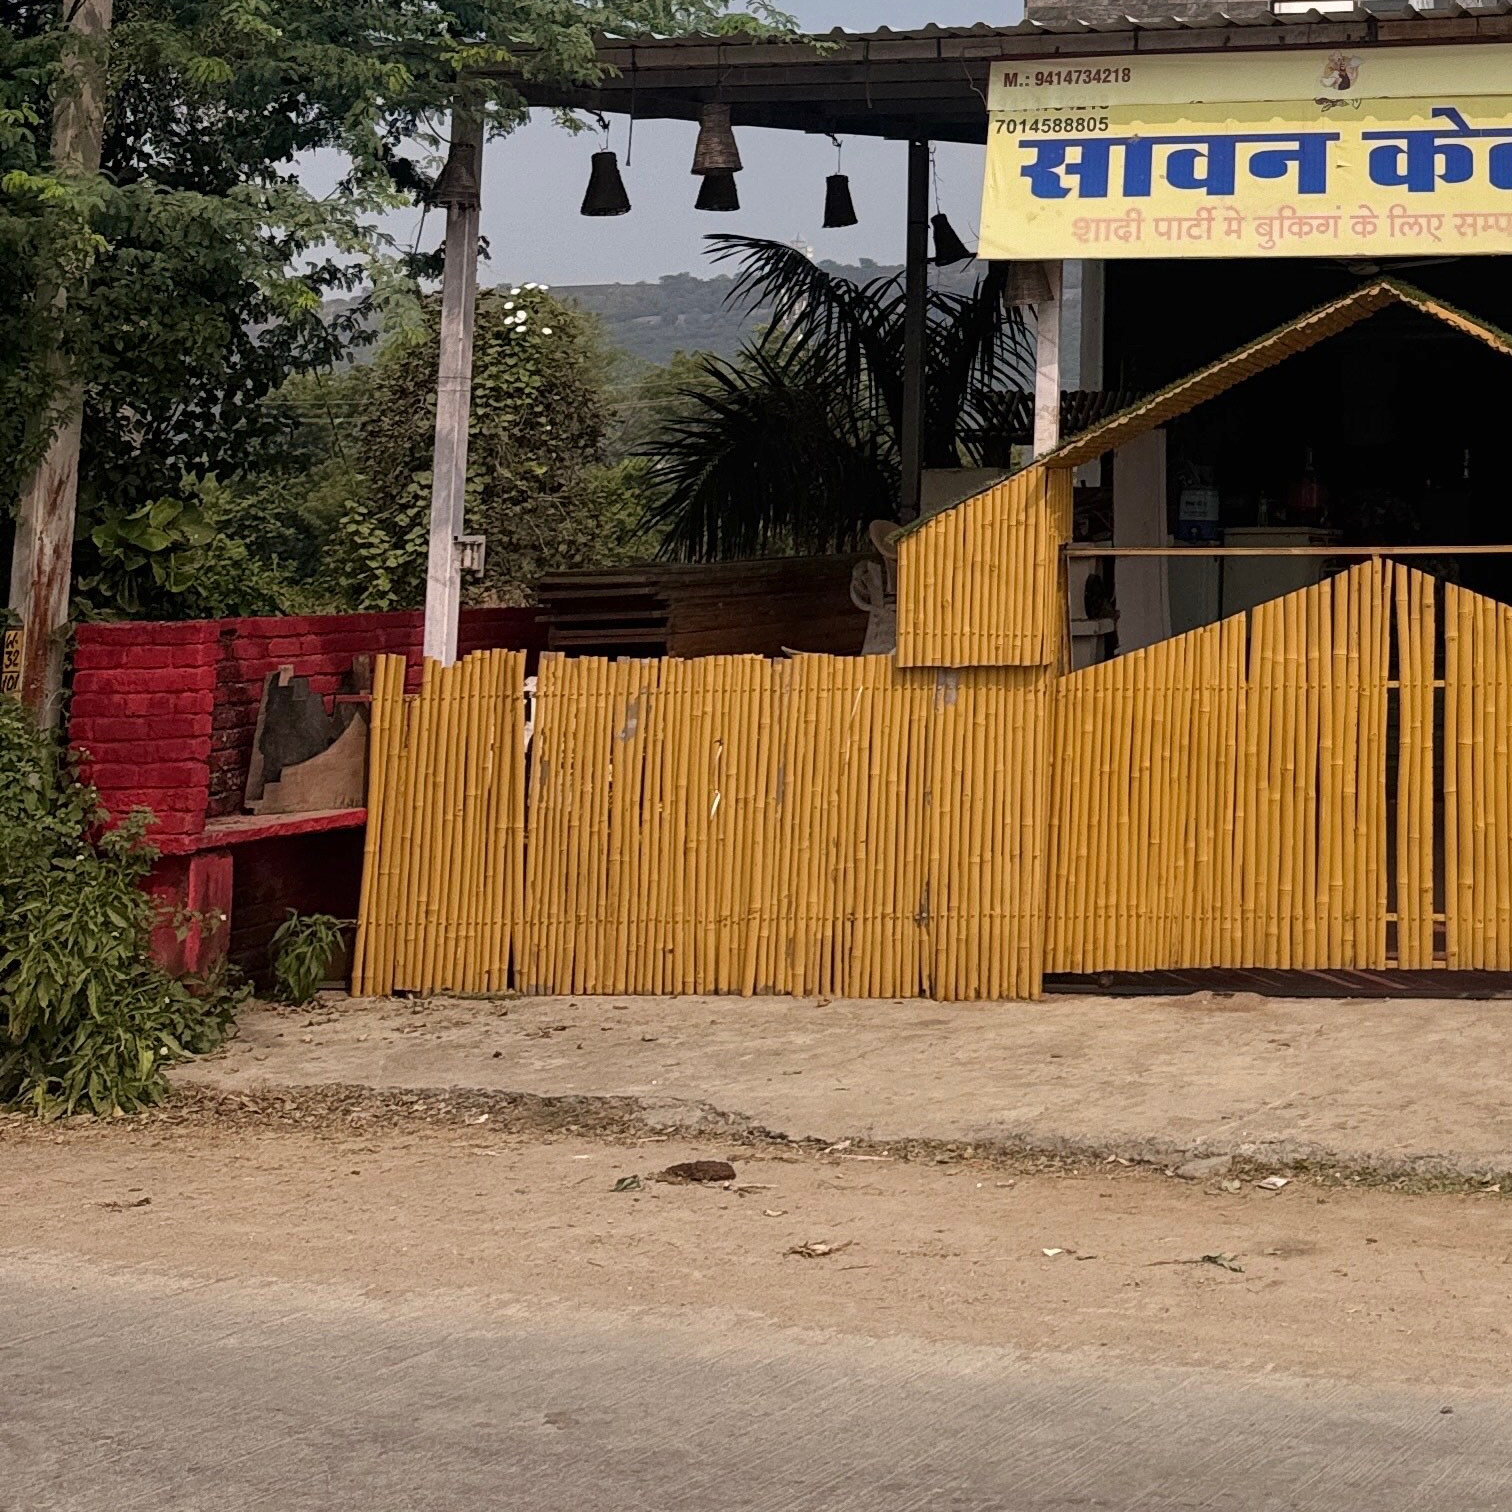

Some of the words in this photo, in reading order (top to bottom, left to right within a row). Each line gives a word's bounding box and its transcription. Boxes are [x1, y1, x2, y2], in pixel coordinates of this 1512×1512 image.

[1003, 72, 1030, 88] M.:
[1034, 67, 1131, 87] 9414734218
[995, 116, 1109, 135] 7014588805
[1018, 131, 1340, 199] सावन
[1072, 208, 1144, 244] शादी
[1153, 206, 1216, 241] पार्टी
[1350, 204, 1379, 238] के
[1387, 204, 1445, 242] लिए
[4, 649, 20, 669] 32
